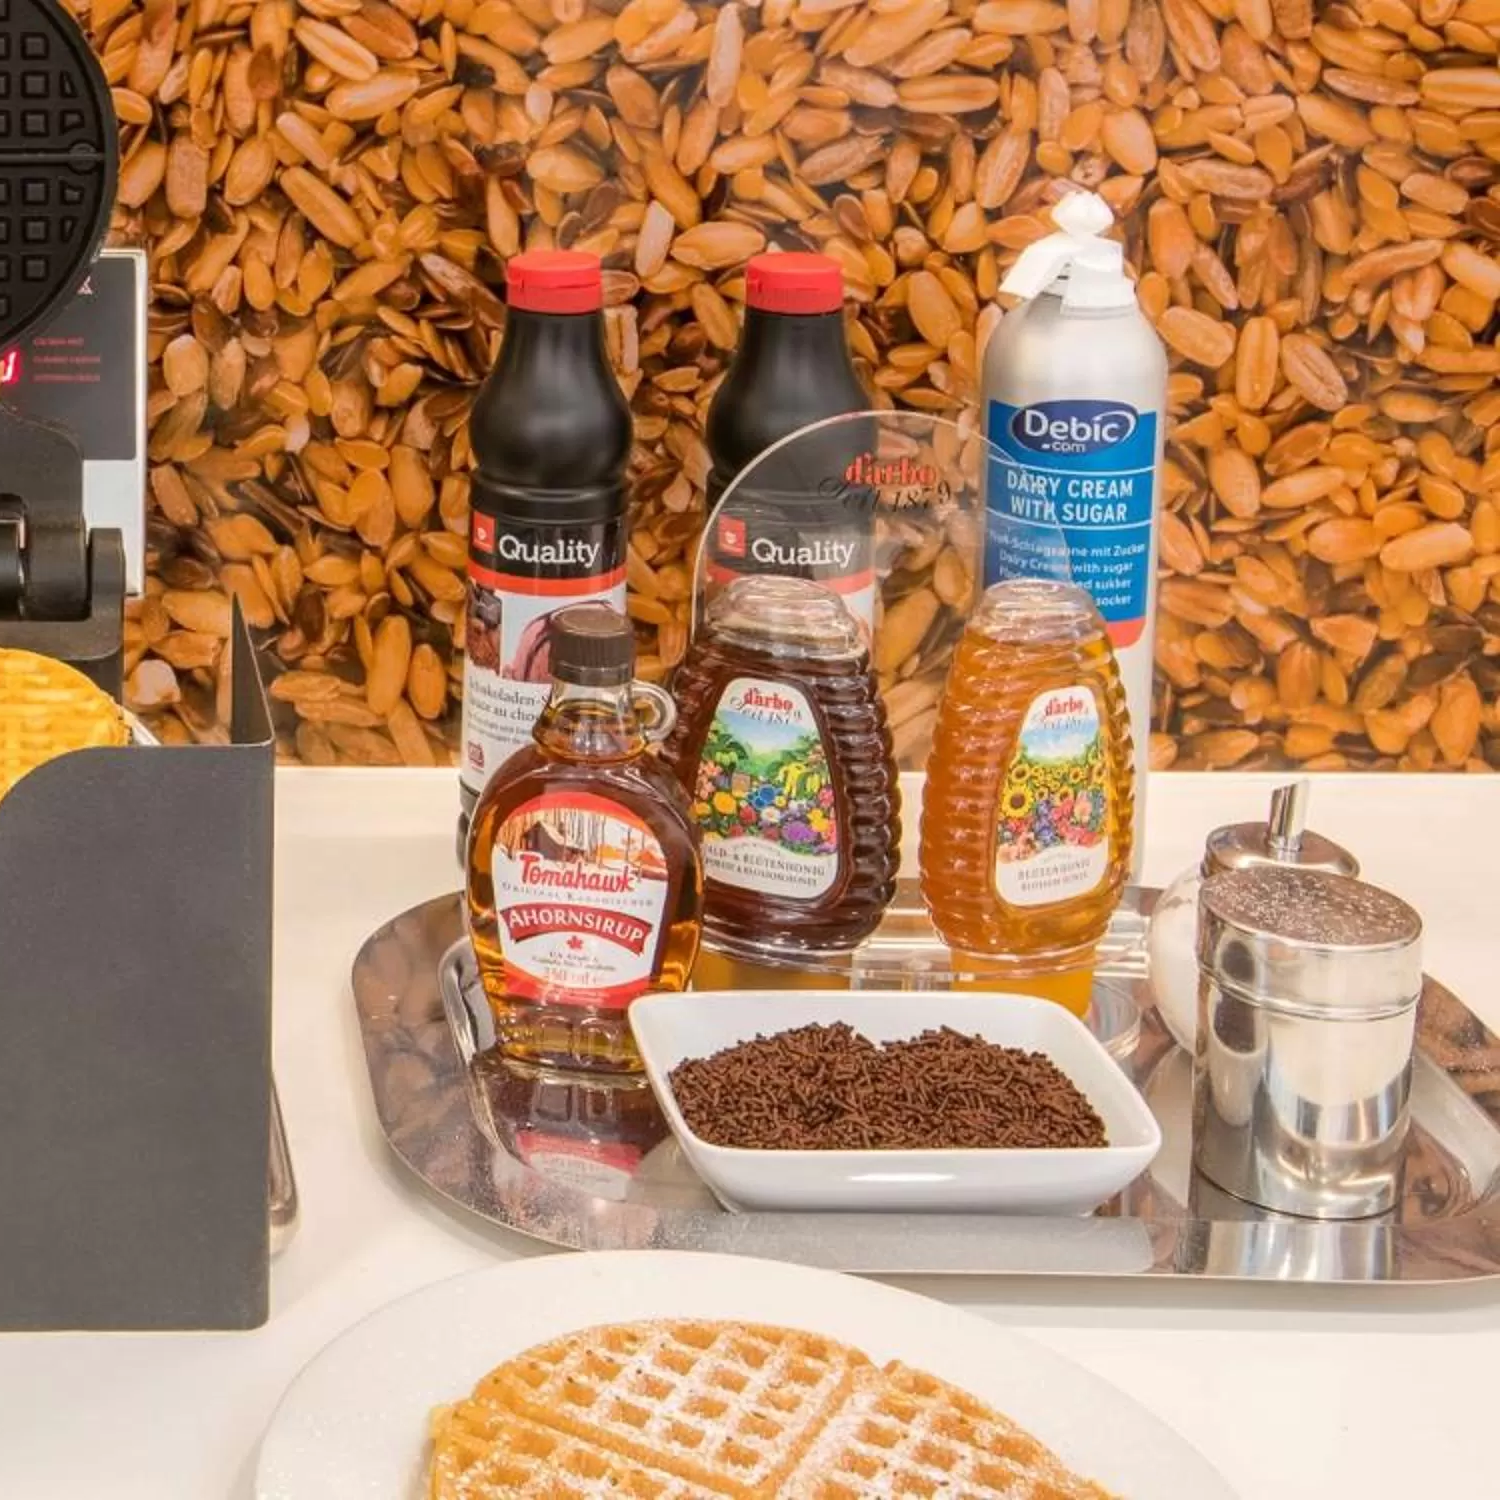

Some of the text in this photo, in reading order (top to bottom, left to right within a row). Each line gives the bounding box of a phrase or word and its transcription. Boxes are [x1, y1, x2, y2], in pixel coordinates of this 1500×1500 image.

[1023, 409, 1120, 443] Debic
[1041, 442, 1086, 453] .com
[1006, 469, 1134, 499] DAIRY CREAM
[1009, 495, 1128, 522] WITH SUGAR
[499, 533, 601, 569] Quality
[751, 537, 855, 569] Quality
[1072, 562, 1100, 574] with
[519, 851, 635, 894] Tomahawk
[508, 907, 645, 943] AHORNSIRUP
